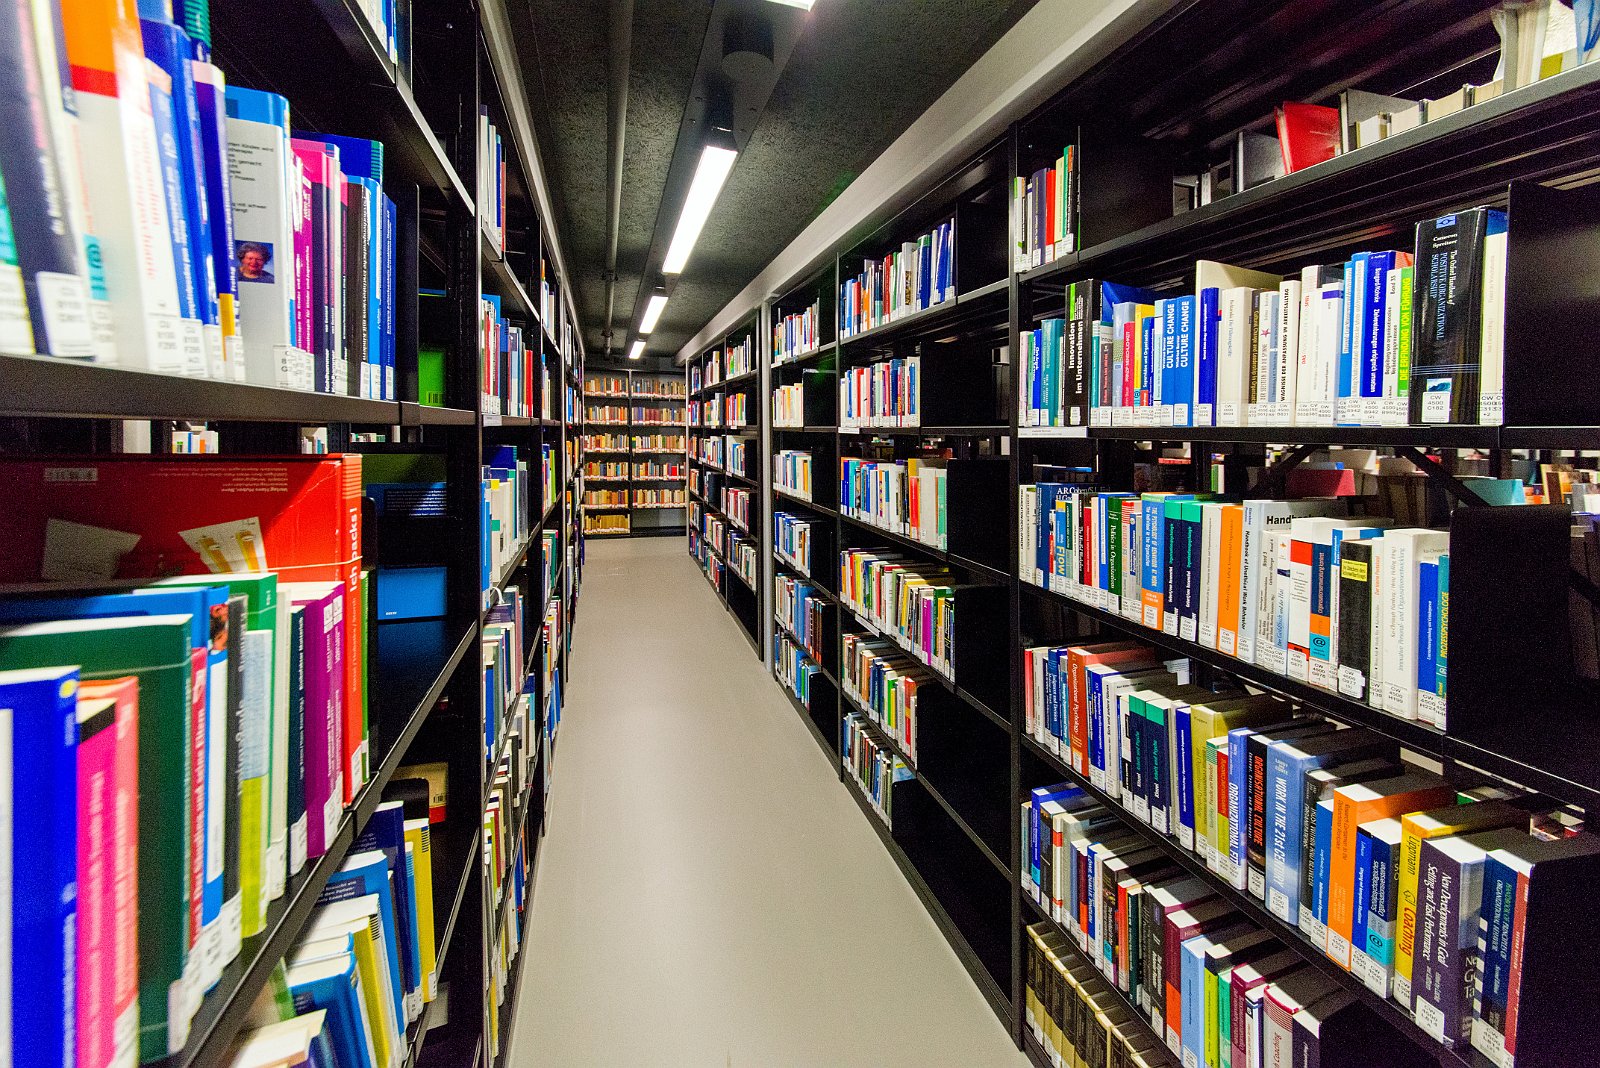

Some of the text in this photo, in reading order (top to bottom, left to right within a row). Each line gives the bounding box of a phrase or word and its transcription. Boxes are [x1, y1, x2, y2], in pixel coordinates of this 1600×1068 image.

[1430, 254, 1438, 299] SCHOLARSHIP
[1436, 252, 1448, 340] POSITIVE ORGANIZATIONAL
[1448, 276, 1456, 299] Handbook
[1181, 301, 1189, 331] CHANGE
[1372, 309, 1380, 348] Zielvereinbarungen
[1400, 278, 1411, 380] DIE ERFINDUNG VON FÜHRUNG
[1075, 383, 1082, 394] im
[349, 507, 359, 592] Ich packs!
[1440, 592, 1449, 658] PROZESSPSYCHOLOGIE
[1229, 782, 1238, 865] ORGANIZATIONAL FIT
[1253, 756, 1264, 846] ORGANISATIONAL CULTURE
[1273, 777, 1286, 887] WORK IN THE 21st CENTURY
[1371, 860, 1379, 912] Sozialpsychologisches
[1378, 861, 1386, 916] Organisationsverstehen
[1401, 836, 1420, 957] Lippmann Coaching
[1441, 873, 1451, 889] New
[1422, 864, 1437, 961] Setting and Task Performance
[1439, 890, 1451, 940] Developments
[1491, 880, 1503, 952] ORGANIZATIONAL BEHAVIOR
[1500, 882, 1513, 960] HANDBOOK OF PRINCIPLES OF
[1437, 948, 1449, 967] Goal
[1273, 1032, 1281, 1063] Coaching
